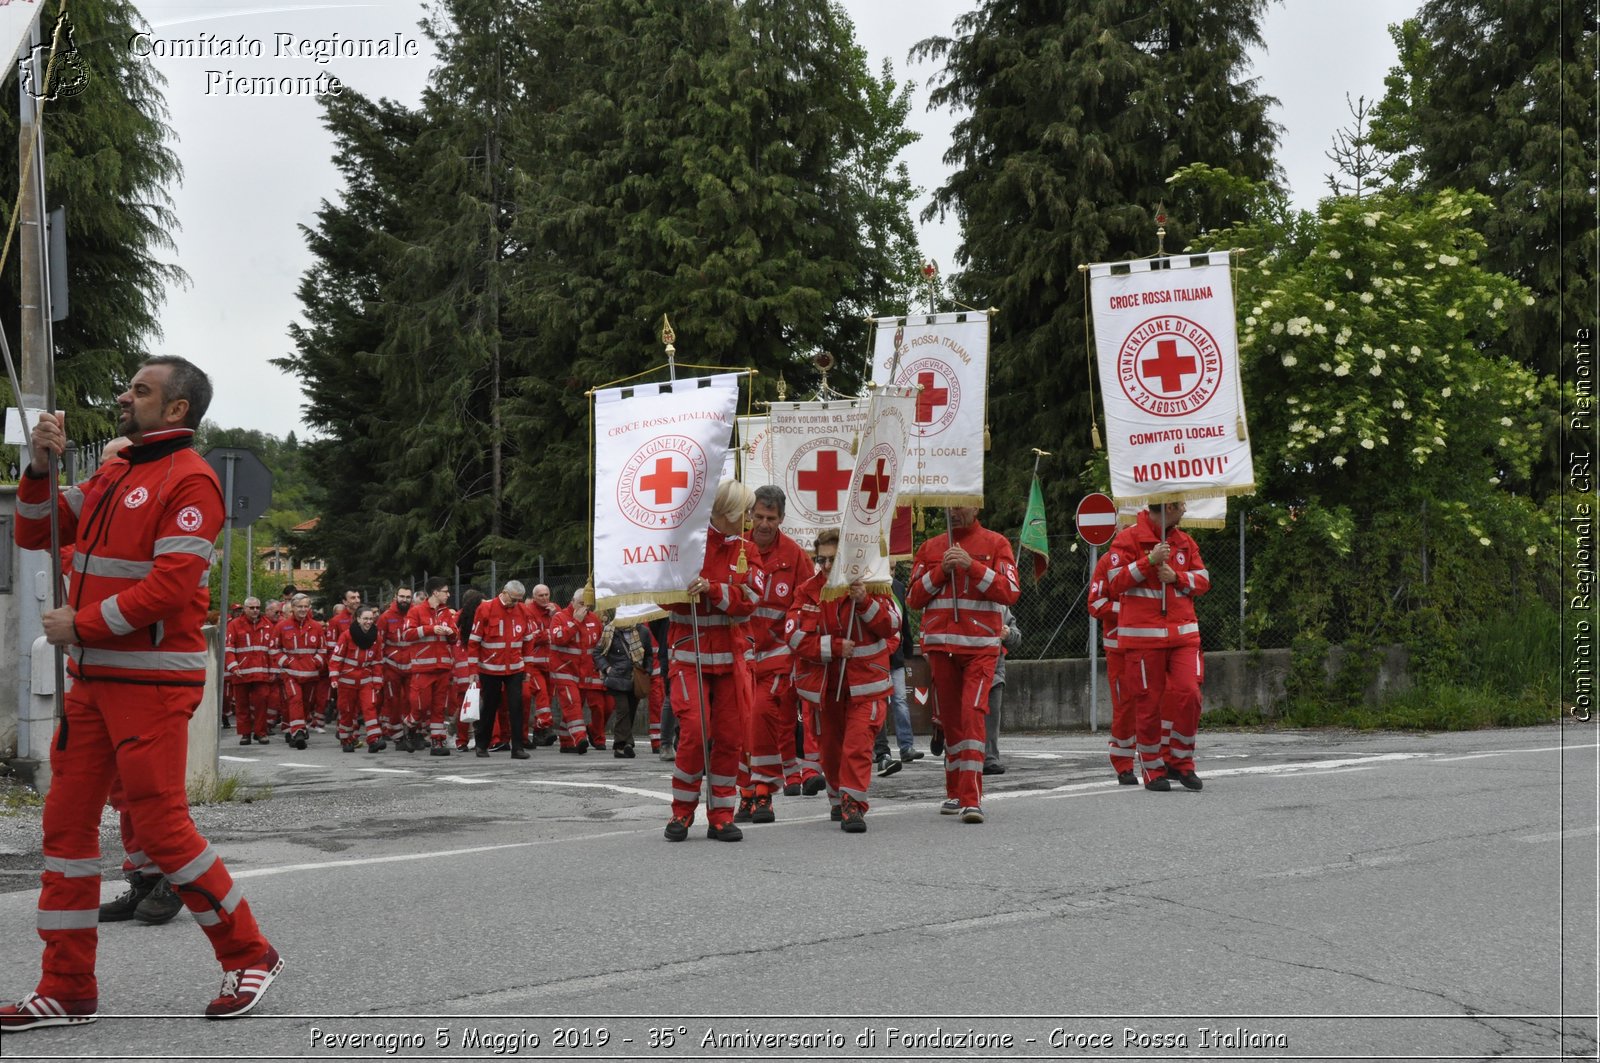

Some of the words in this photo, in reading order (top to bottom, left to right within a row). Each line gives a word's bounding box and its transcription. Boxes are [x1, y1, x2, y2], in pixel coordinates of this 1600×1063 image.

[1110, 293, 1140, 310] CROCE
[1142, 290, 1171, 305] ROSSA
[1173, 286, 1213, 302] ITALIANA
[884, 344, 910, 370] CRCE
[911, 335, 939, 348] ROSSA
[942, 337, 971, 366] ITALIANA
[1123, 319, 1171, 381] CONVENZIONE
[1175, 320, 1187, 332] DI
[1189, 328, 1218, 373] GINEVRA
[914, 360, 943, 371] GINEVRA
[943, 367, 952, 378] 22
[949, 376, 959, 409] AGOSTO
[1135, 392, 1149, 407] 22
[1149, 399, 1188, 413] AGOSTO
[1188, 388, 1209, 407] 1864
[608, 421, 640, 437] CROCE
[642, 415, 676, 429] ROSSA
[678, 411, 727, 423] ITALIANA
[777, 415, 796, 424] CORPO
[832, 415, 843, 423] DEL
[846, 413, 868, 422] SOCCOR
[772, 426, 804, 435] CROCE
[807, 426, 838, 434] ROSSA
[1129, 428, 1183, 446] COMITATO
[1186, 426, 1225, 439] LOCALE
[646, 438, 693, 455] GINEVRA
[788, 439, 829, 471] CONVENZIONE
[931, 448, 967, 456] LOCALE
[1173, 443, 1185, 455] di
[634, 451, 646, 464] DI
[917, 462, 926, 470] DI
[1133, 456, 1228, 483] MONDOVI'
[902, 475, 949, 485] RONERO
[620, 463, 657, 525] CONVENZIONE
[855, 548, 866, 559] DI
